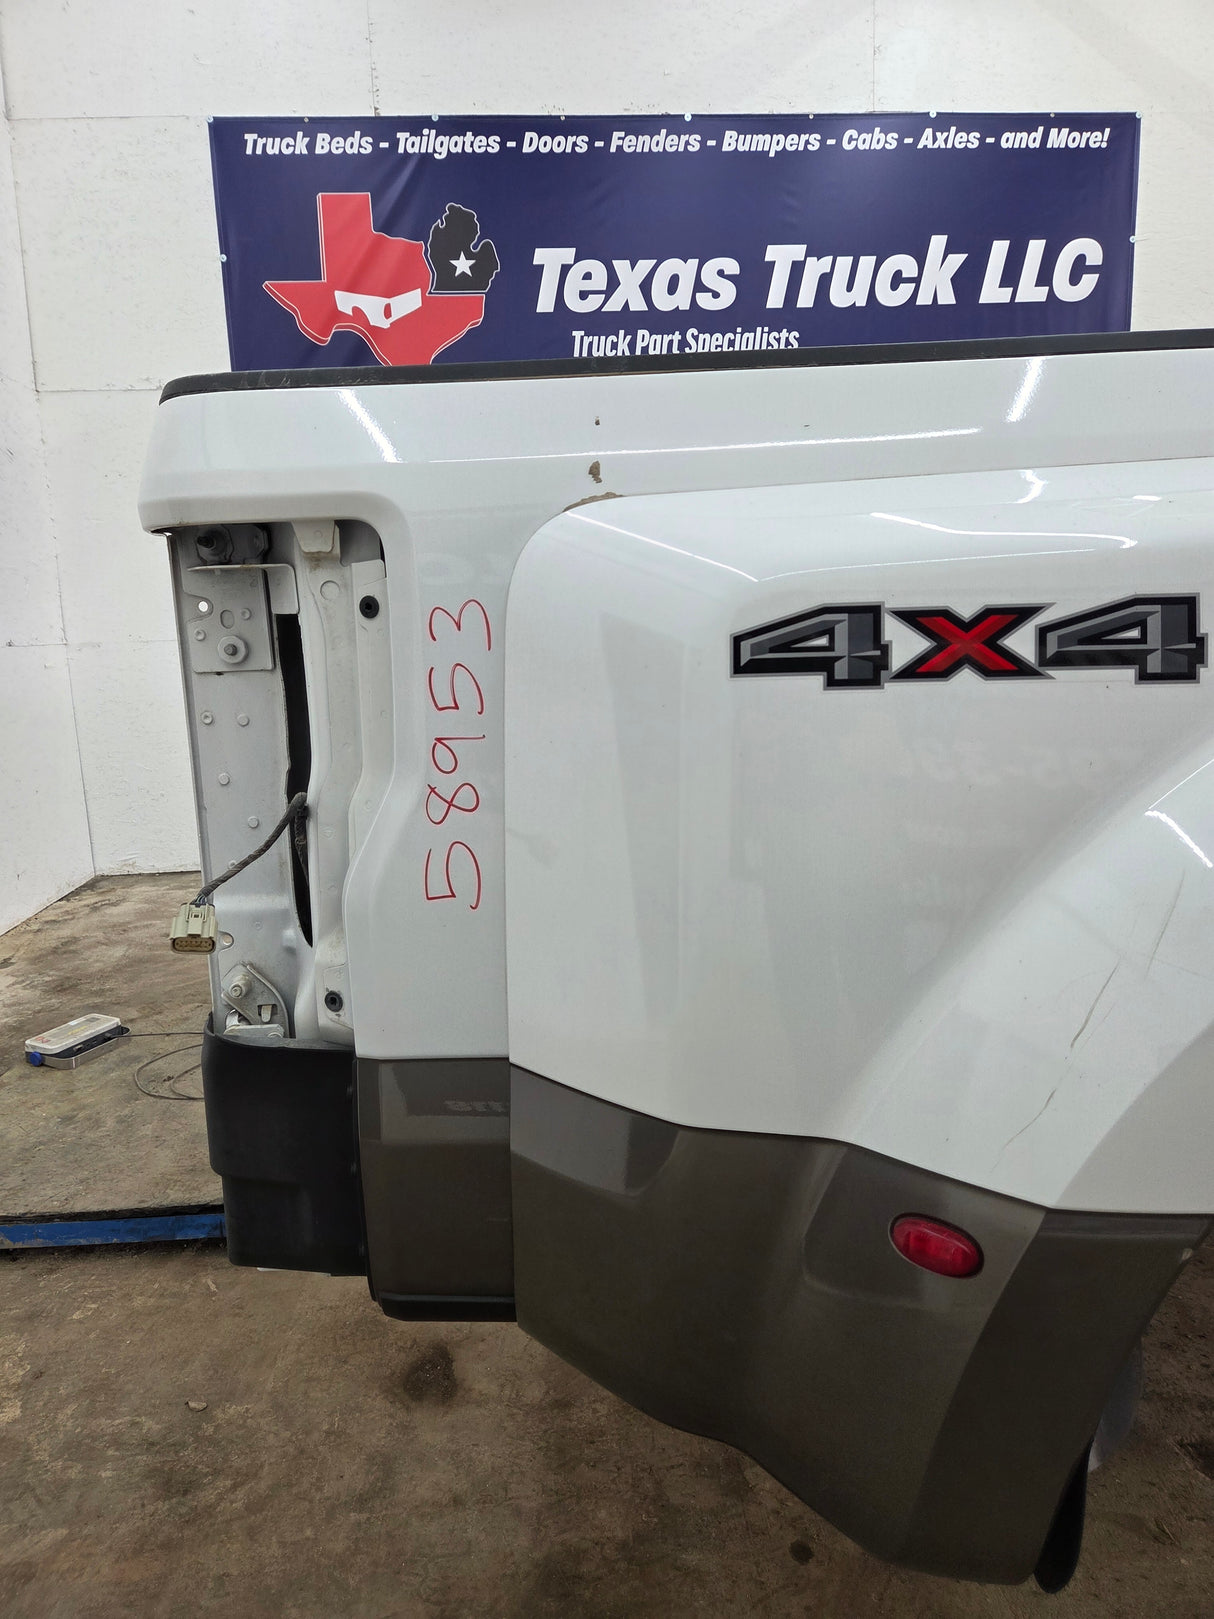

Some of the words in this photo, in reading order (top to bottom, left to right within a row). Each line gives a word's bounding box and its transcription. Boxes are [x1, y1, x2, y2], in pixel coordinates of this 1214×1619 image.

[244, 131, 310, 155] Truck
[315, 132, 373, 155] Beds
[397, 129, 501, 159] Tailgates
[523, 131, 588, 154] Doors
[610, 128, 702, 153] Fenders
[722, 130, 821, 157] Bumpers
[842, 128, 899, 151] Cabs
[917, 126, 981, 149] Axles
[1001, 126, 1044, 149] and
[1047, 127, 1111, 149] More!
[532, 247, 741, 313] Texas
[764, 234, 968, 309] Truck
[979, 237, 1104, 304] LLC
[571, 329, 633, 357] Truck
[636, 329, 682, 356] Part
[684, 326, 800, 353] Specialists
[425, 599, 492, 911] 58953
